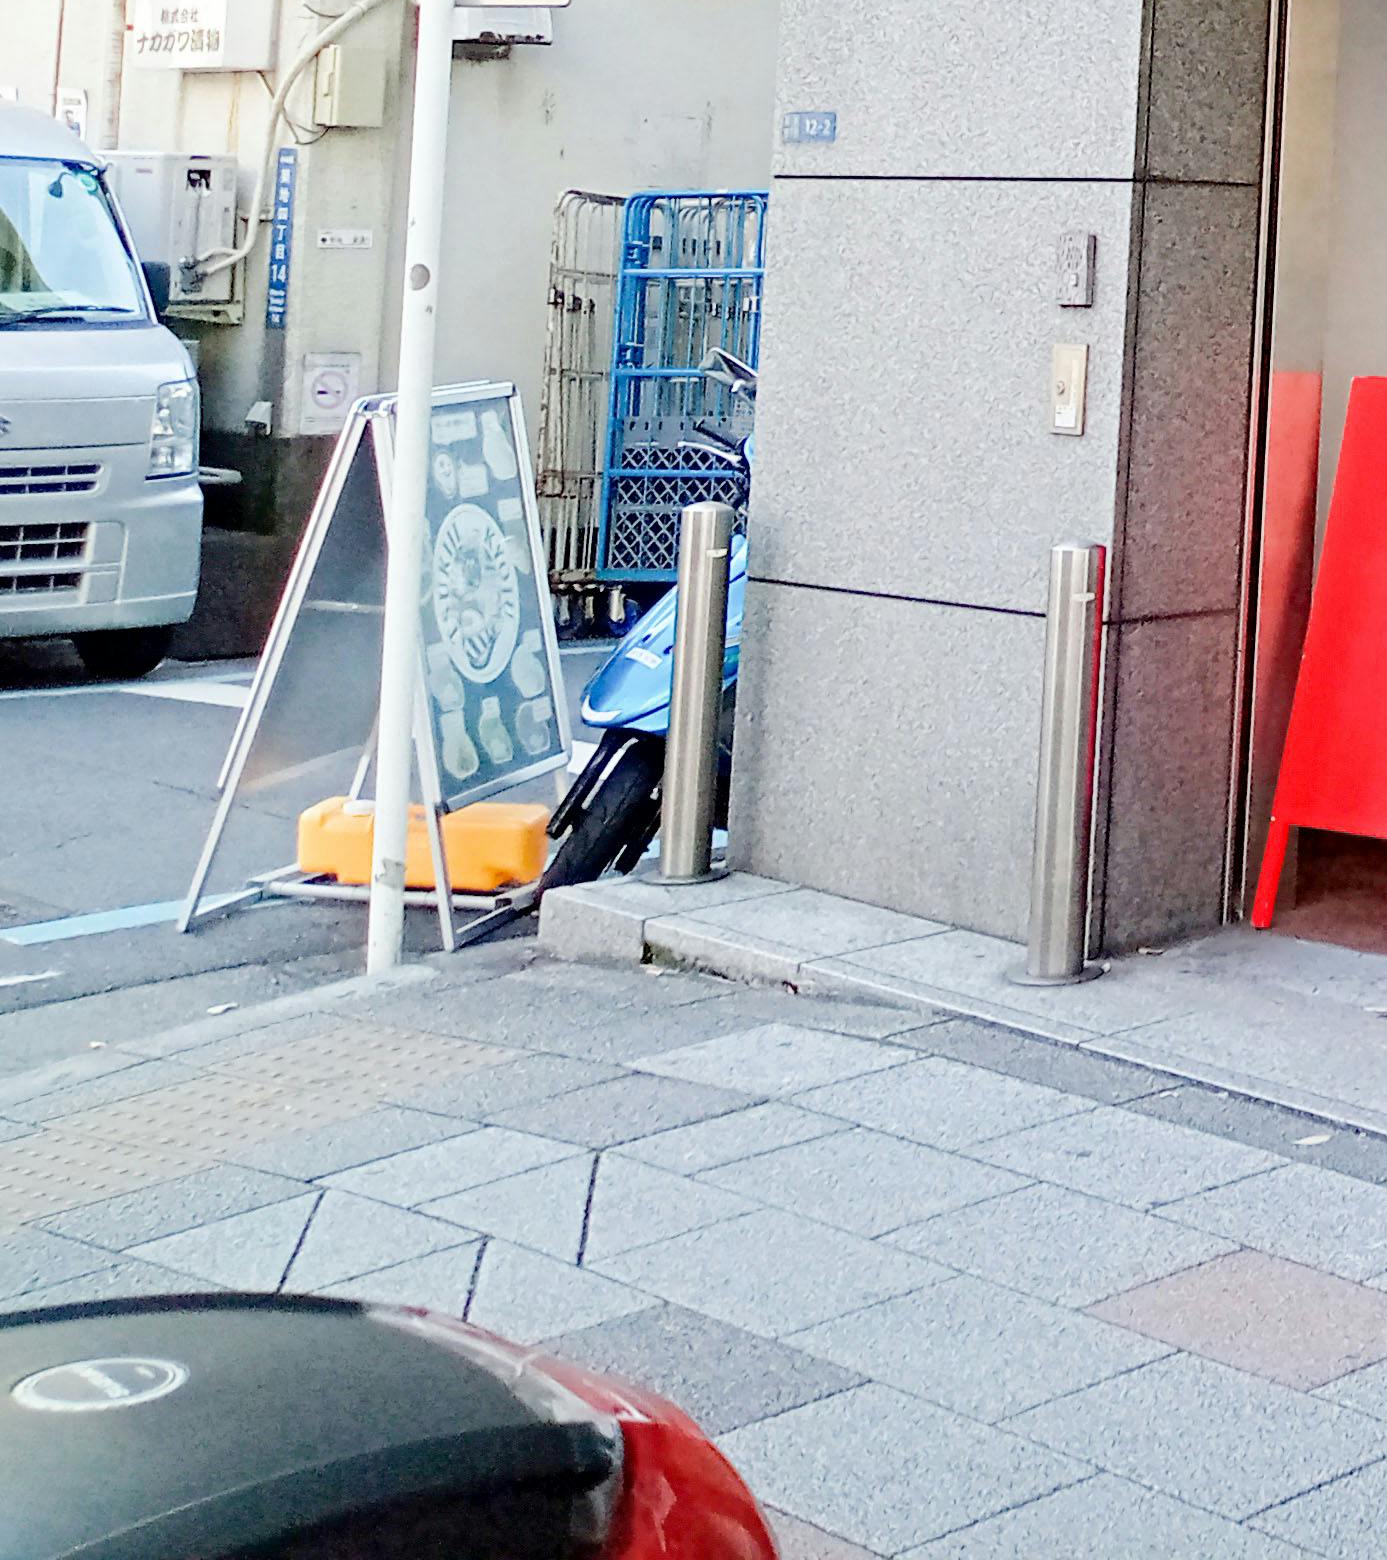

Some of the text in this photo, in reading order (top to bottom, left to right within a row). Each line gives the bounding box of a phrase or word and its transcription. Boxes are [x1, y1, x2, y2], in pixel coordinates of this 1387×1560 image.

[161, 8, 199, 24] 株式会社
[805, 119, 831, 137] 12-2
